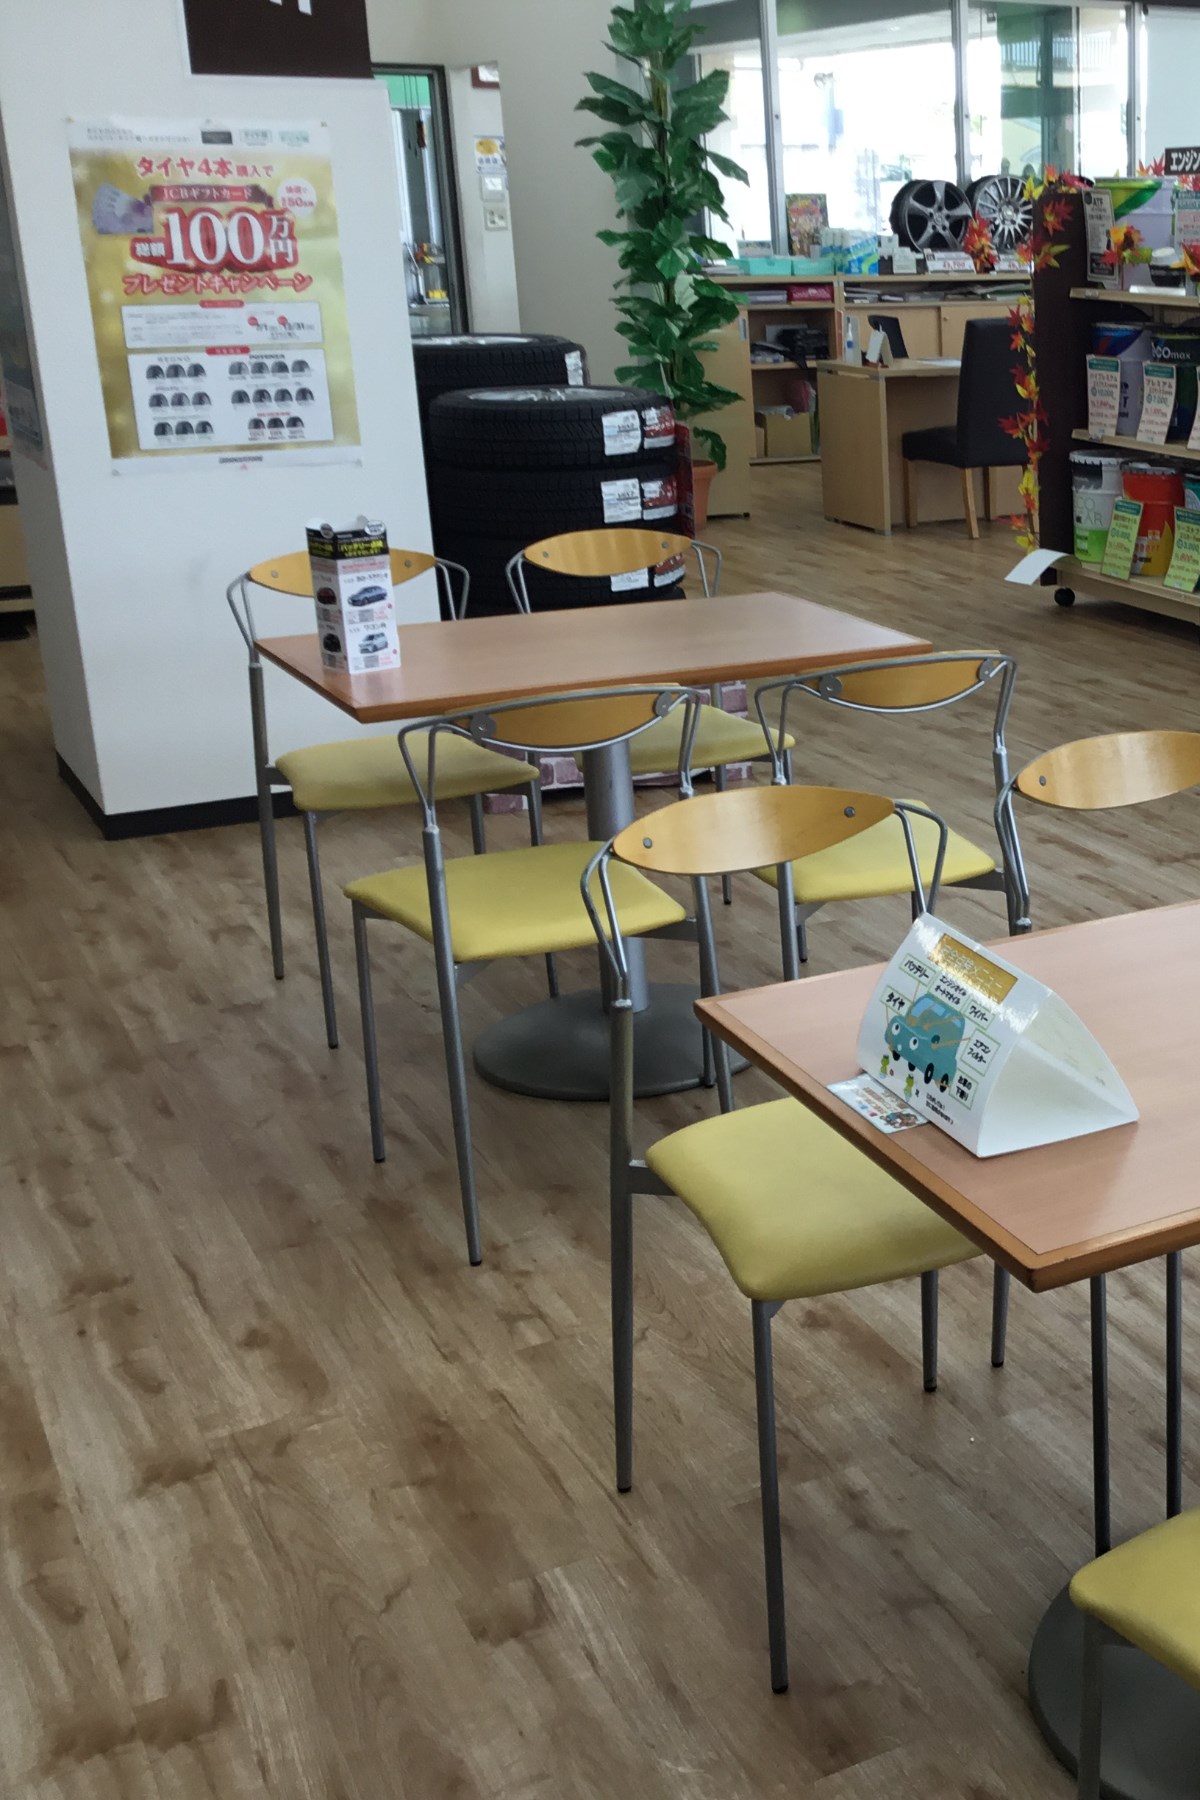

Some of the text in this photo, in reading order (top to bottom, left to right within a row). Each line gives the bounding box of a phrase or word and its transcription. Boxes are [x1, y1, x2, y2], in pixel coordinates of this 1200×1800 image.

[137, 156, 274, 178] タイヤ4本購入で
[162, 187, 254, 200] JCBギフトカード
[123, 272, 314, 296] プレゼントキャンペーン
[904, 959, 930, 979] バッテリー
[939, 975, 967, 997] エンジンオイル
[884, 991, 906, 1010] タイヤ
[969, 1005, 989, 1022] ワイパー
[967, 1047, 987, 1064] フィルター
[973, 1039, 991, 1055] エアコン
